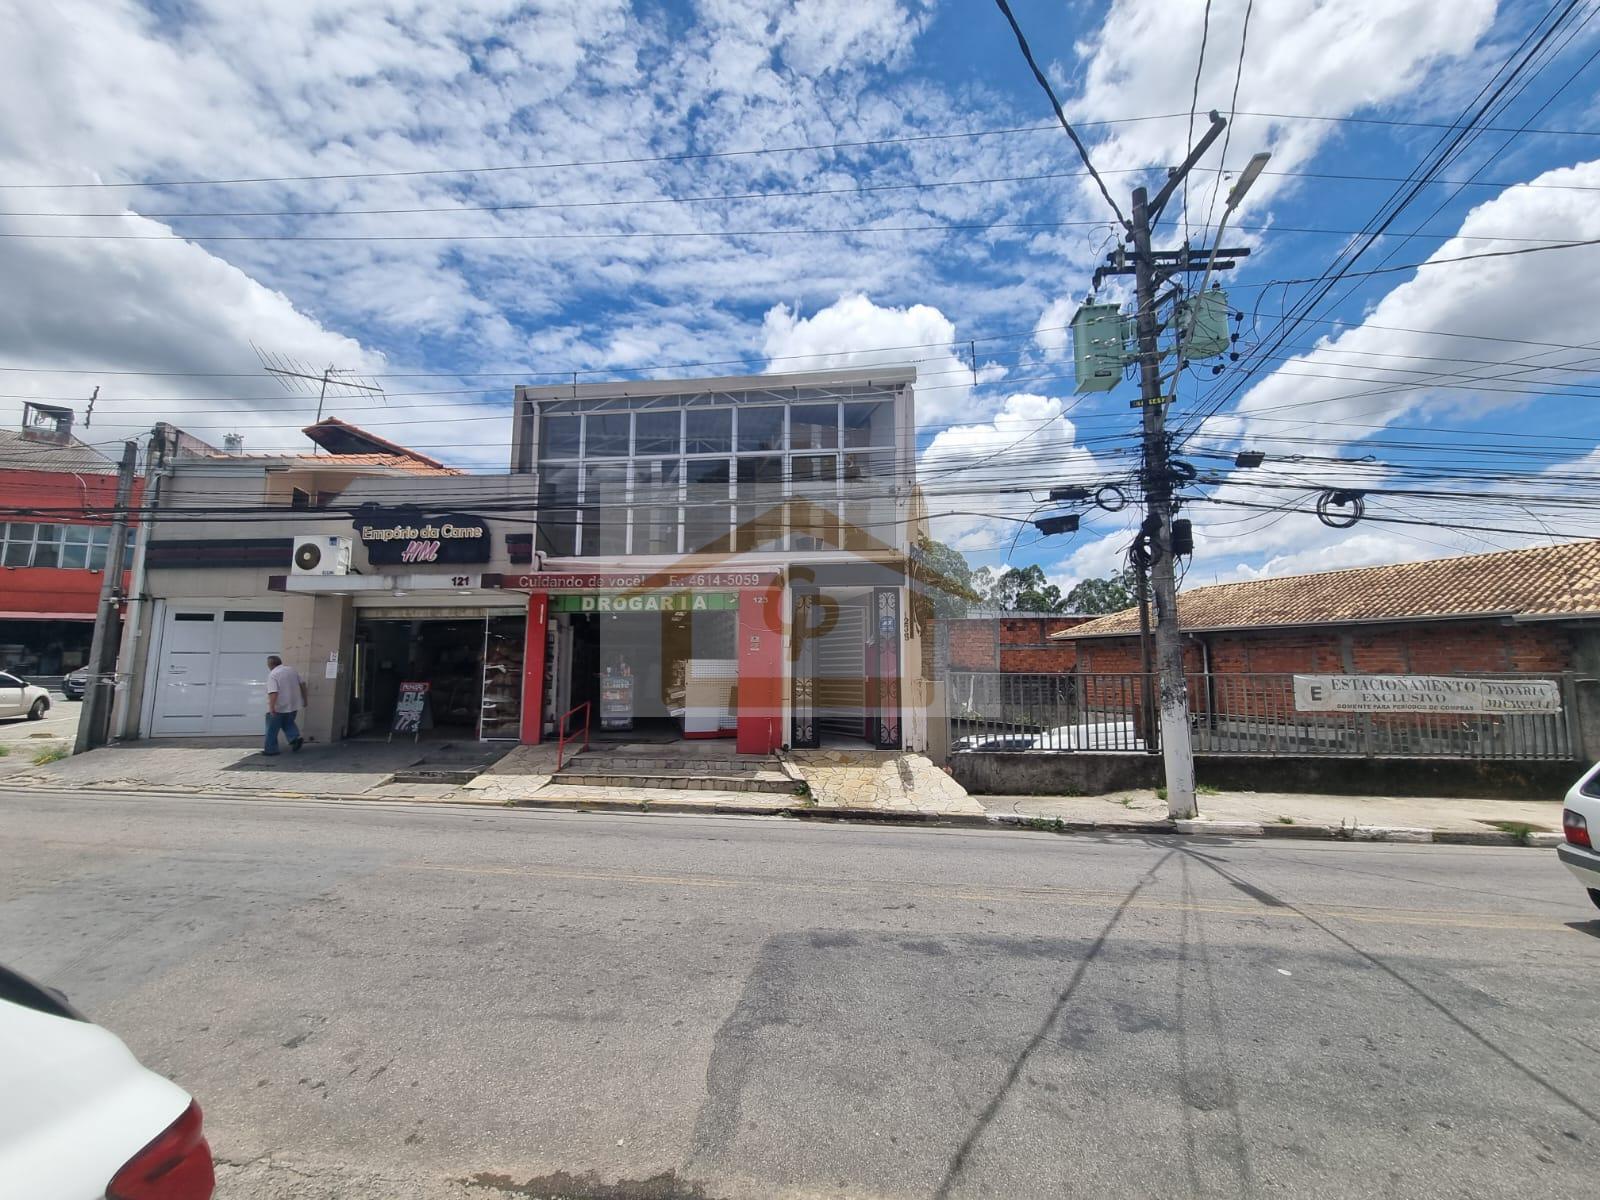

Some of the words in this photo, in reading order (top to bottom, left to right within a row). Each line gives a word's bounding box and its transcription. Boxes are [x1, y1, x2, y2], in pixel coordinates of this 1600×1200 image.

[362, 524, 418, 542] Empório
[420, 524, 440, 539] da
[441, 523, 483, 539] Carne
[451, 576, 469, 586] 121
[519, 575, 583, 587] Cuidando
[588, 575, 605, 587] de
[608, 575, 645, 587] você!
[689, 574, 760, 586] 4614-5059
[581, 595, 708, 611] DROGARIA
[1331, 677, 1477, 693] ESTACIONAMENTO
[1487, 685, 1545, 696] PADARIA
[1310, 686, 1323, 702] E
[1362, 693, 1447, 703] EXCLUSIVO
